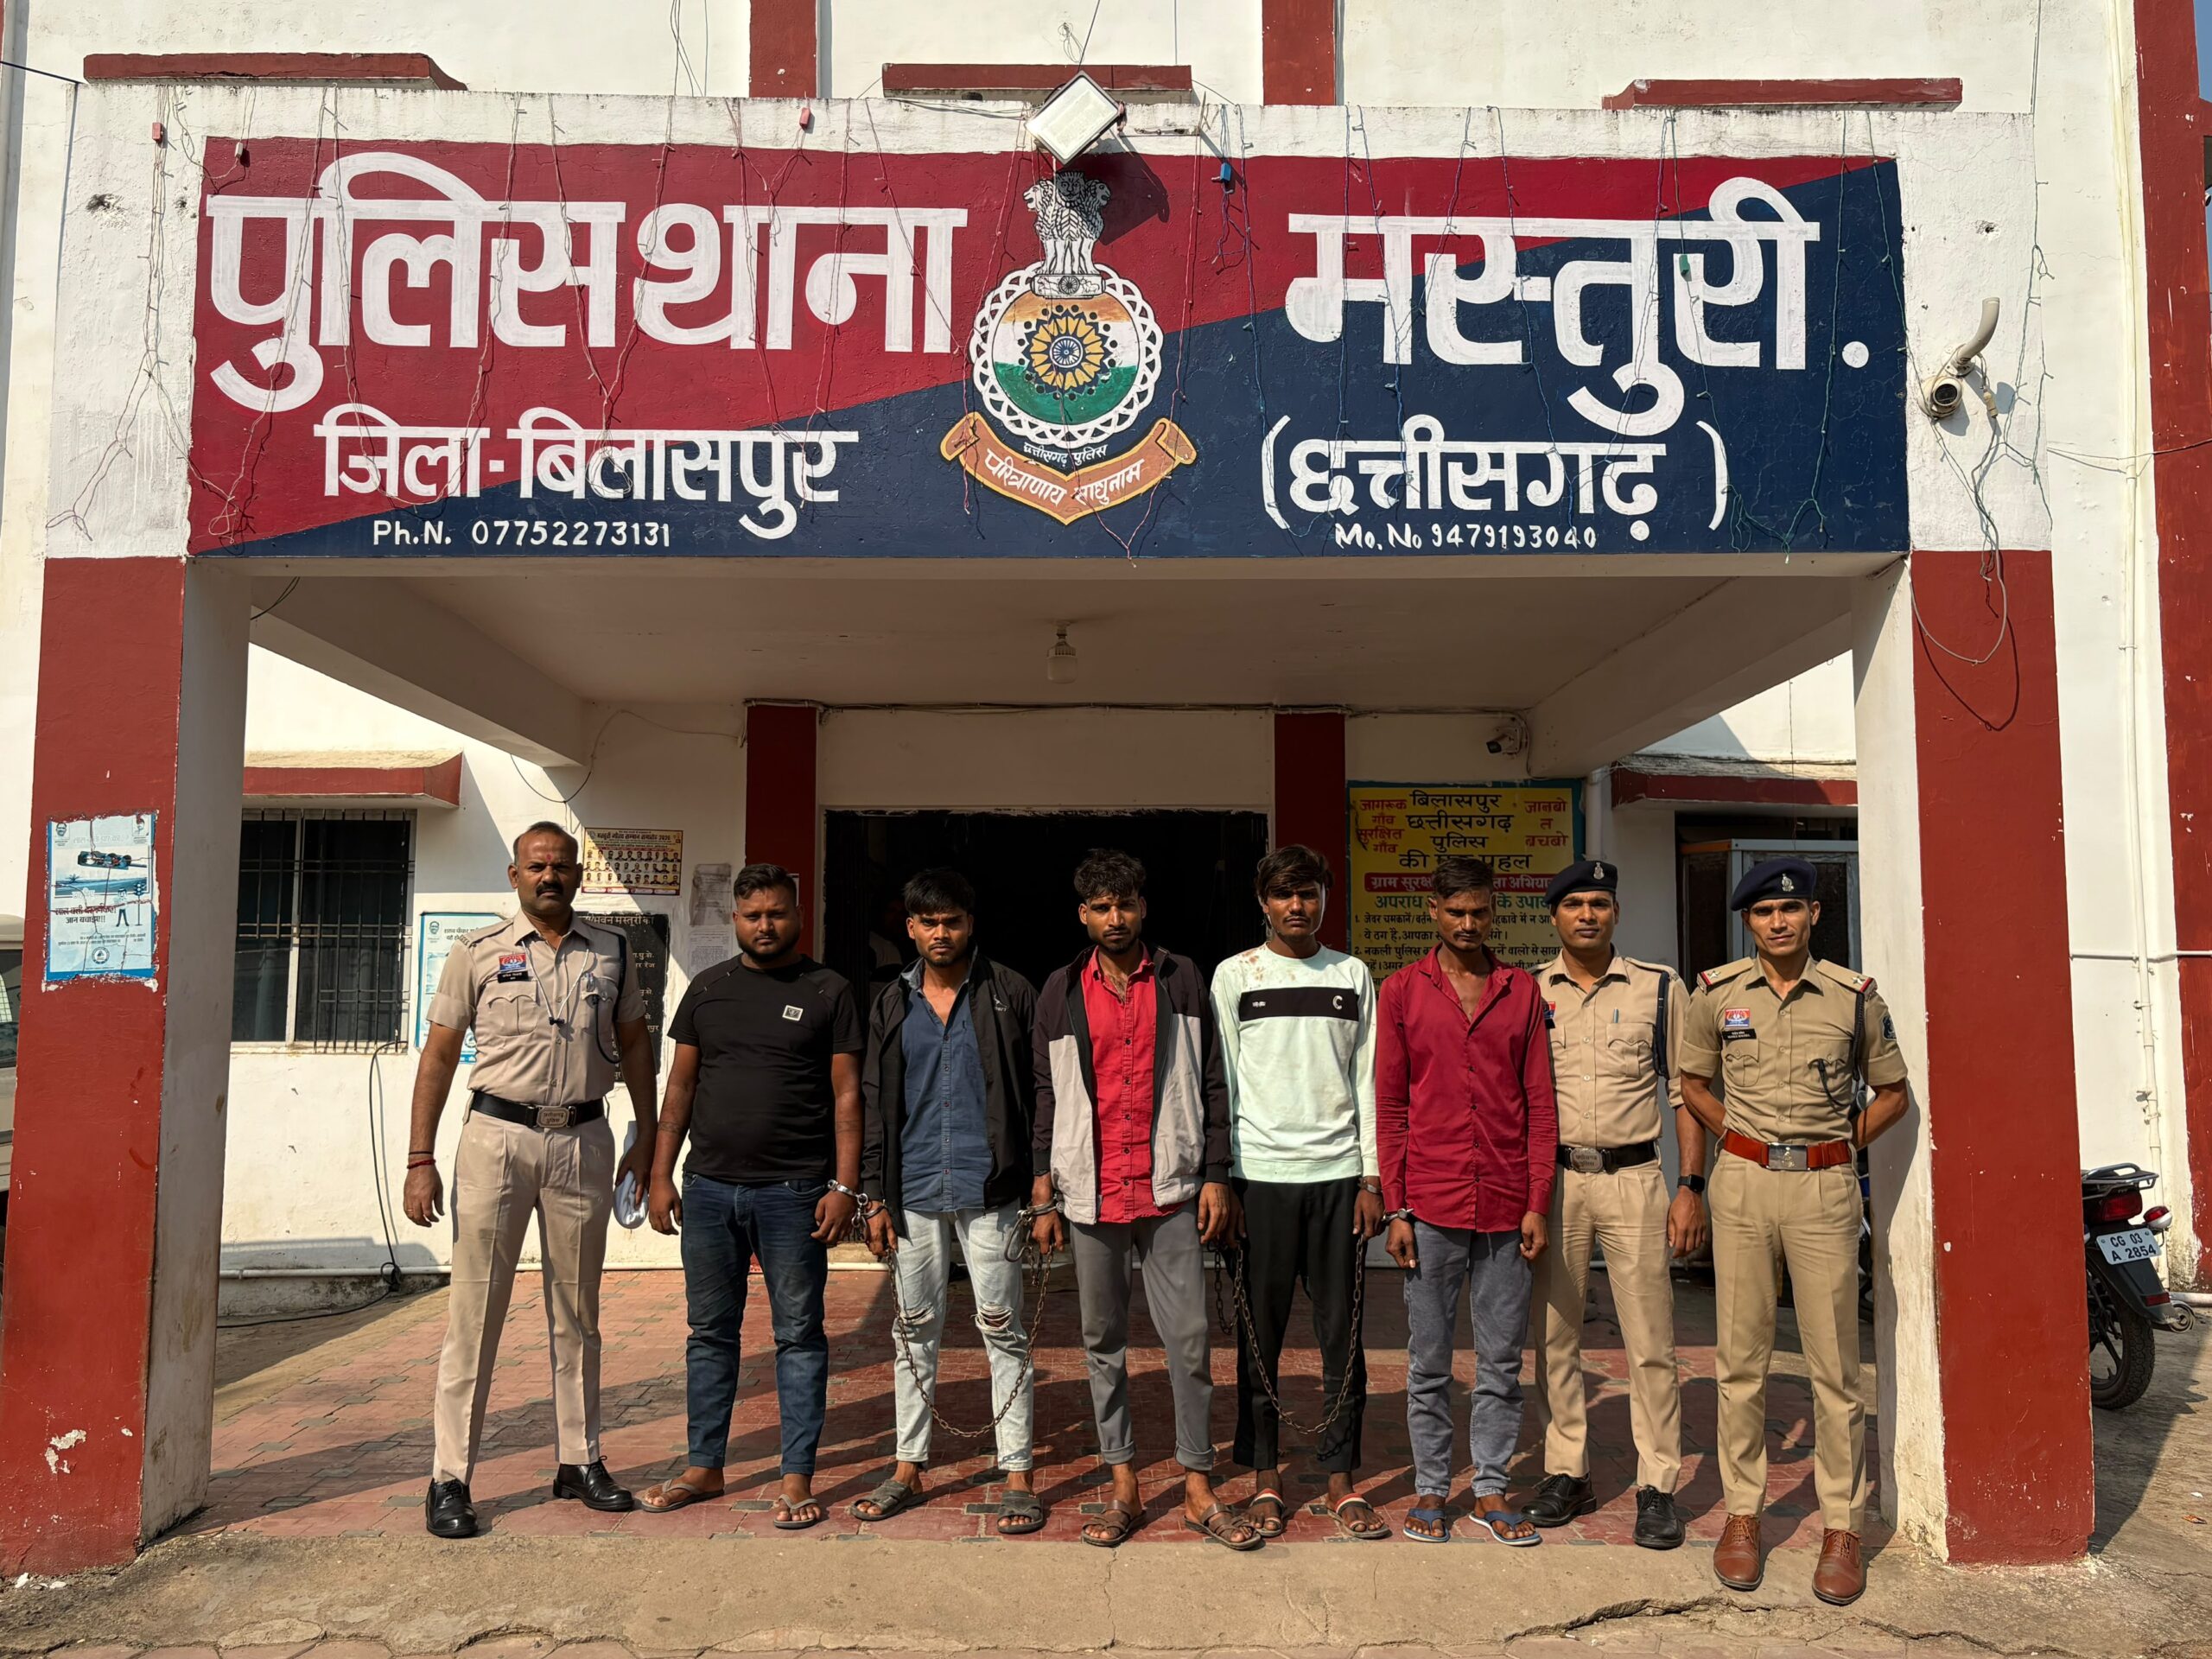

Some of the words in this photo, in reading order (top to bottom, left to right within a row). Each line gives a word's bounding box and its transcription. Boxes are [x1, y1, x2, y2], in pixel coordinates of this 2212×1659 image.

[207, 151, 626, 412] पुलिस
[635, 203, 968, 353] थाना
[1071, 443, 1109, 466] पुलिस
[472, 520, 671, 547] 07752273131
[1431, 522, 1597, 550] 9479193040
[1408, 790, 1503, 813] बिलासपुर
[1405, 810, 1515, 833] छत्तीसगढ़
[1429, 831, 1490, 854] पुलिस
[1398, 849, 1431, 868] की
[1375, 895, 1425, 909] अपराध
[1497, 893, 1513, 909] के
[1394, 944, 1423, 960] पुलिस
[2109, 1236, 2126, 1247] CG
[2129, 1233, 2143, 1244] 03
[2111, 1249, 2121, 1262] A
[2125, 1243, 2157, 1259] 2854
